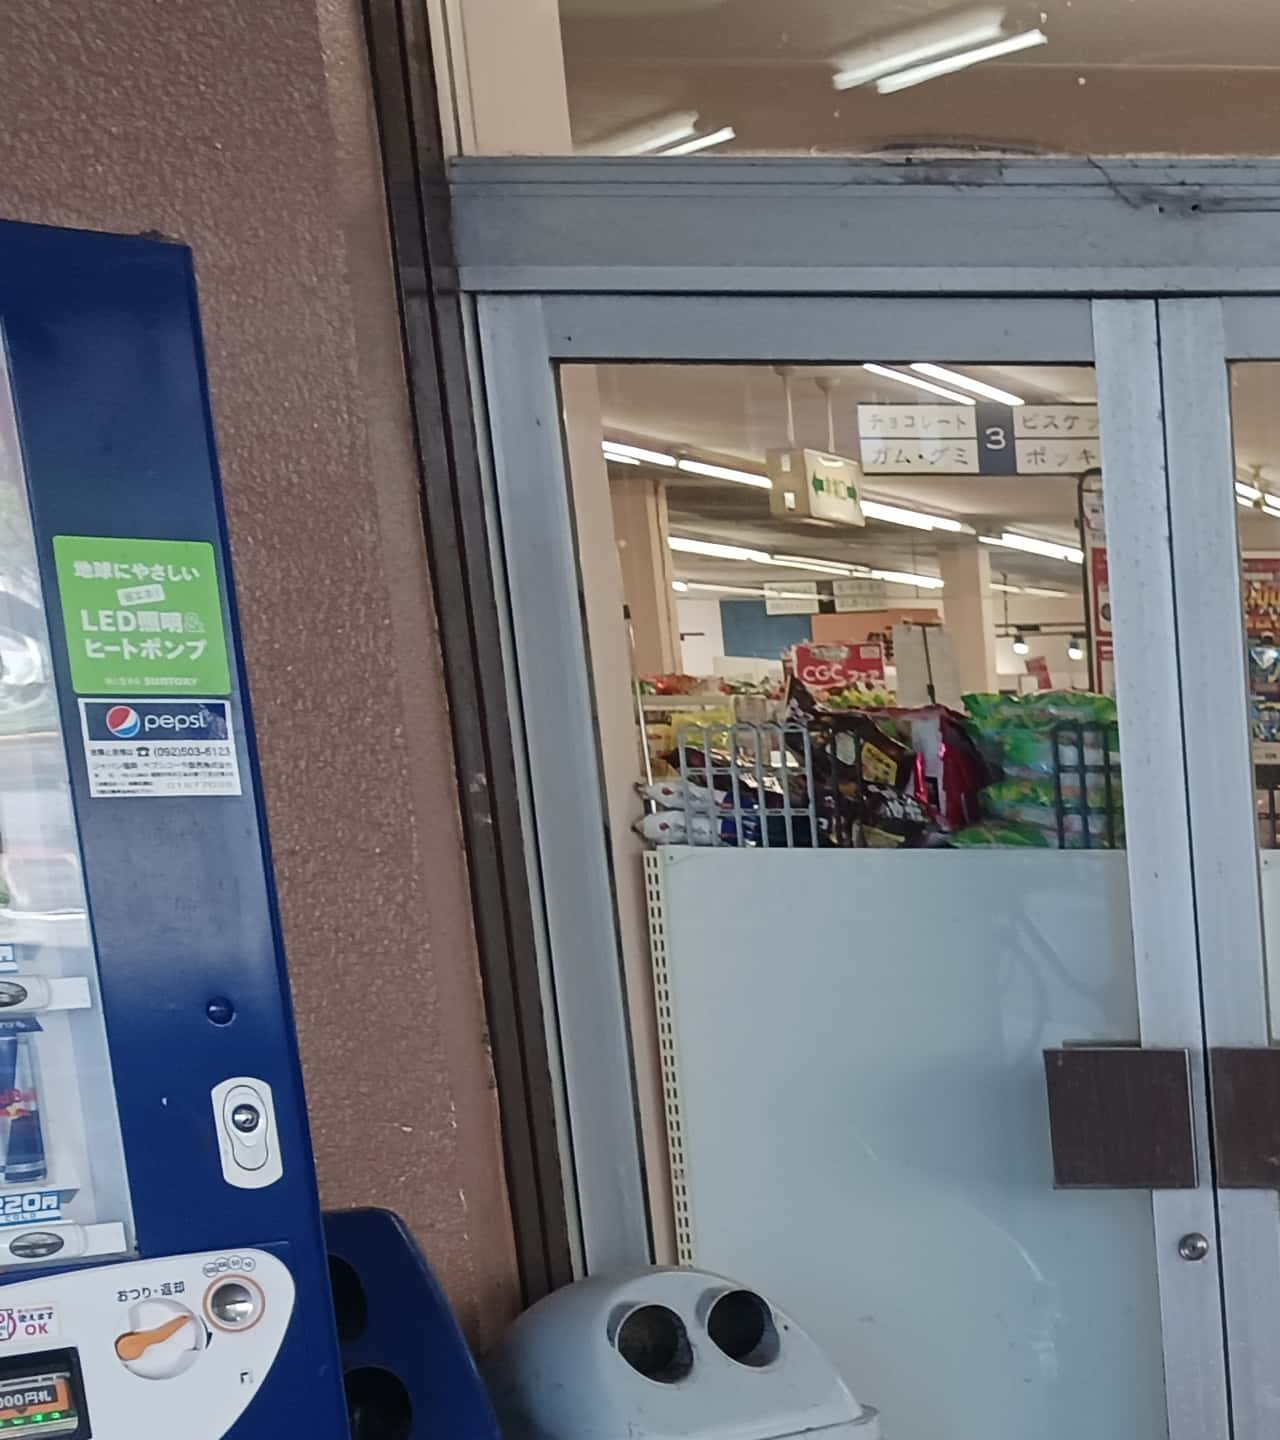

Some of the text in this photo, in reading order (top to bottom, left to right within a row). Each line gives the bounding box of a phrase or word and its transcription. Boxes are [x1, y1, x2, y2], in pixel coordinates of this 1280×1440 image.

[868, 413, 967, 431] チョコレート
[984, 427, 1007, 451] 3
[73, 560, 201, 582] 地球にやさしい
[85, 638, 208, 661] ヒートポンプ
[803, 663, 842, 681] CGC
[144, 711, 208, 732] pepsi
[24, 1322, 49, 1336] OK
[0, 1390, 52, 1408] 00円札
